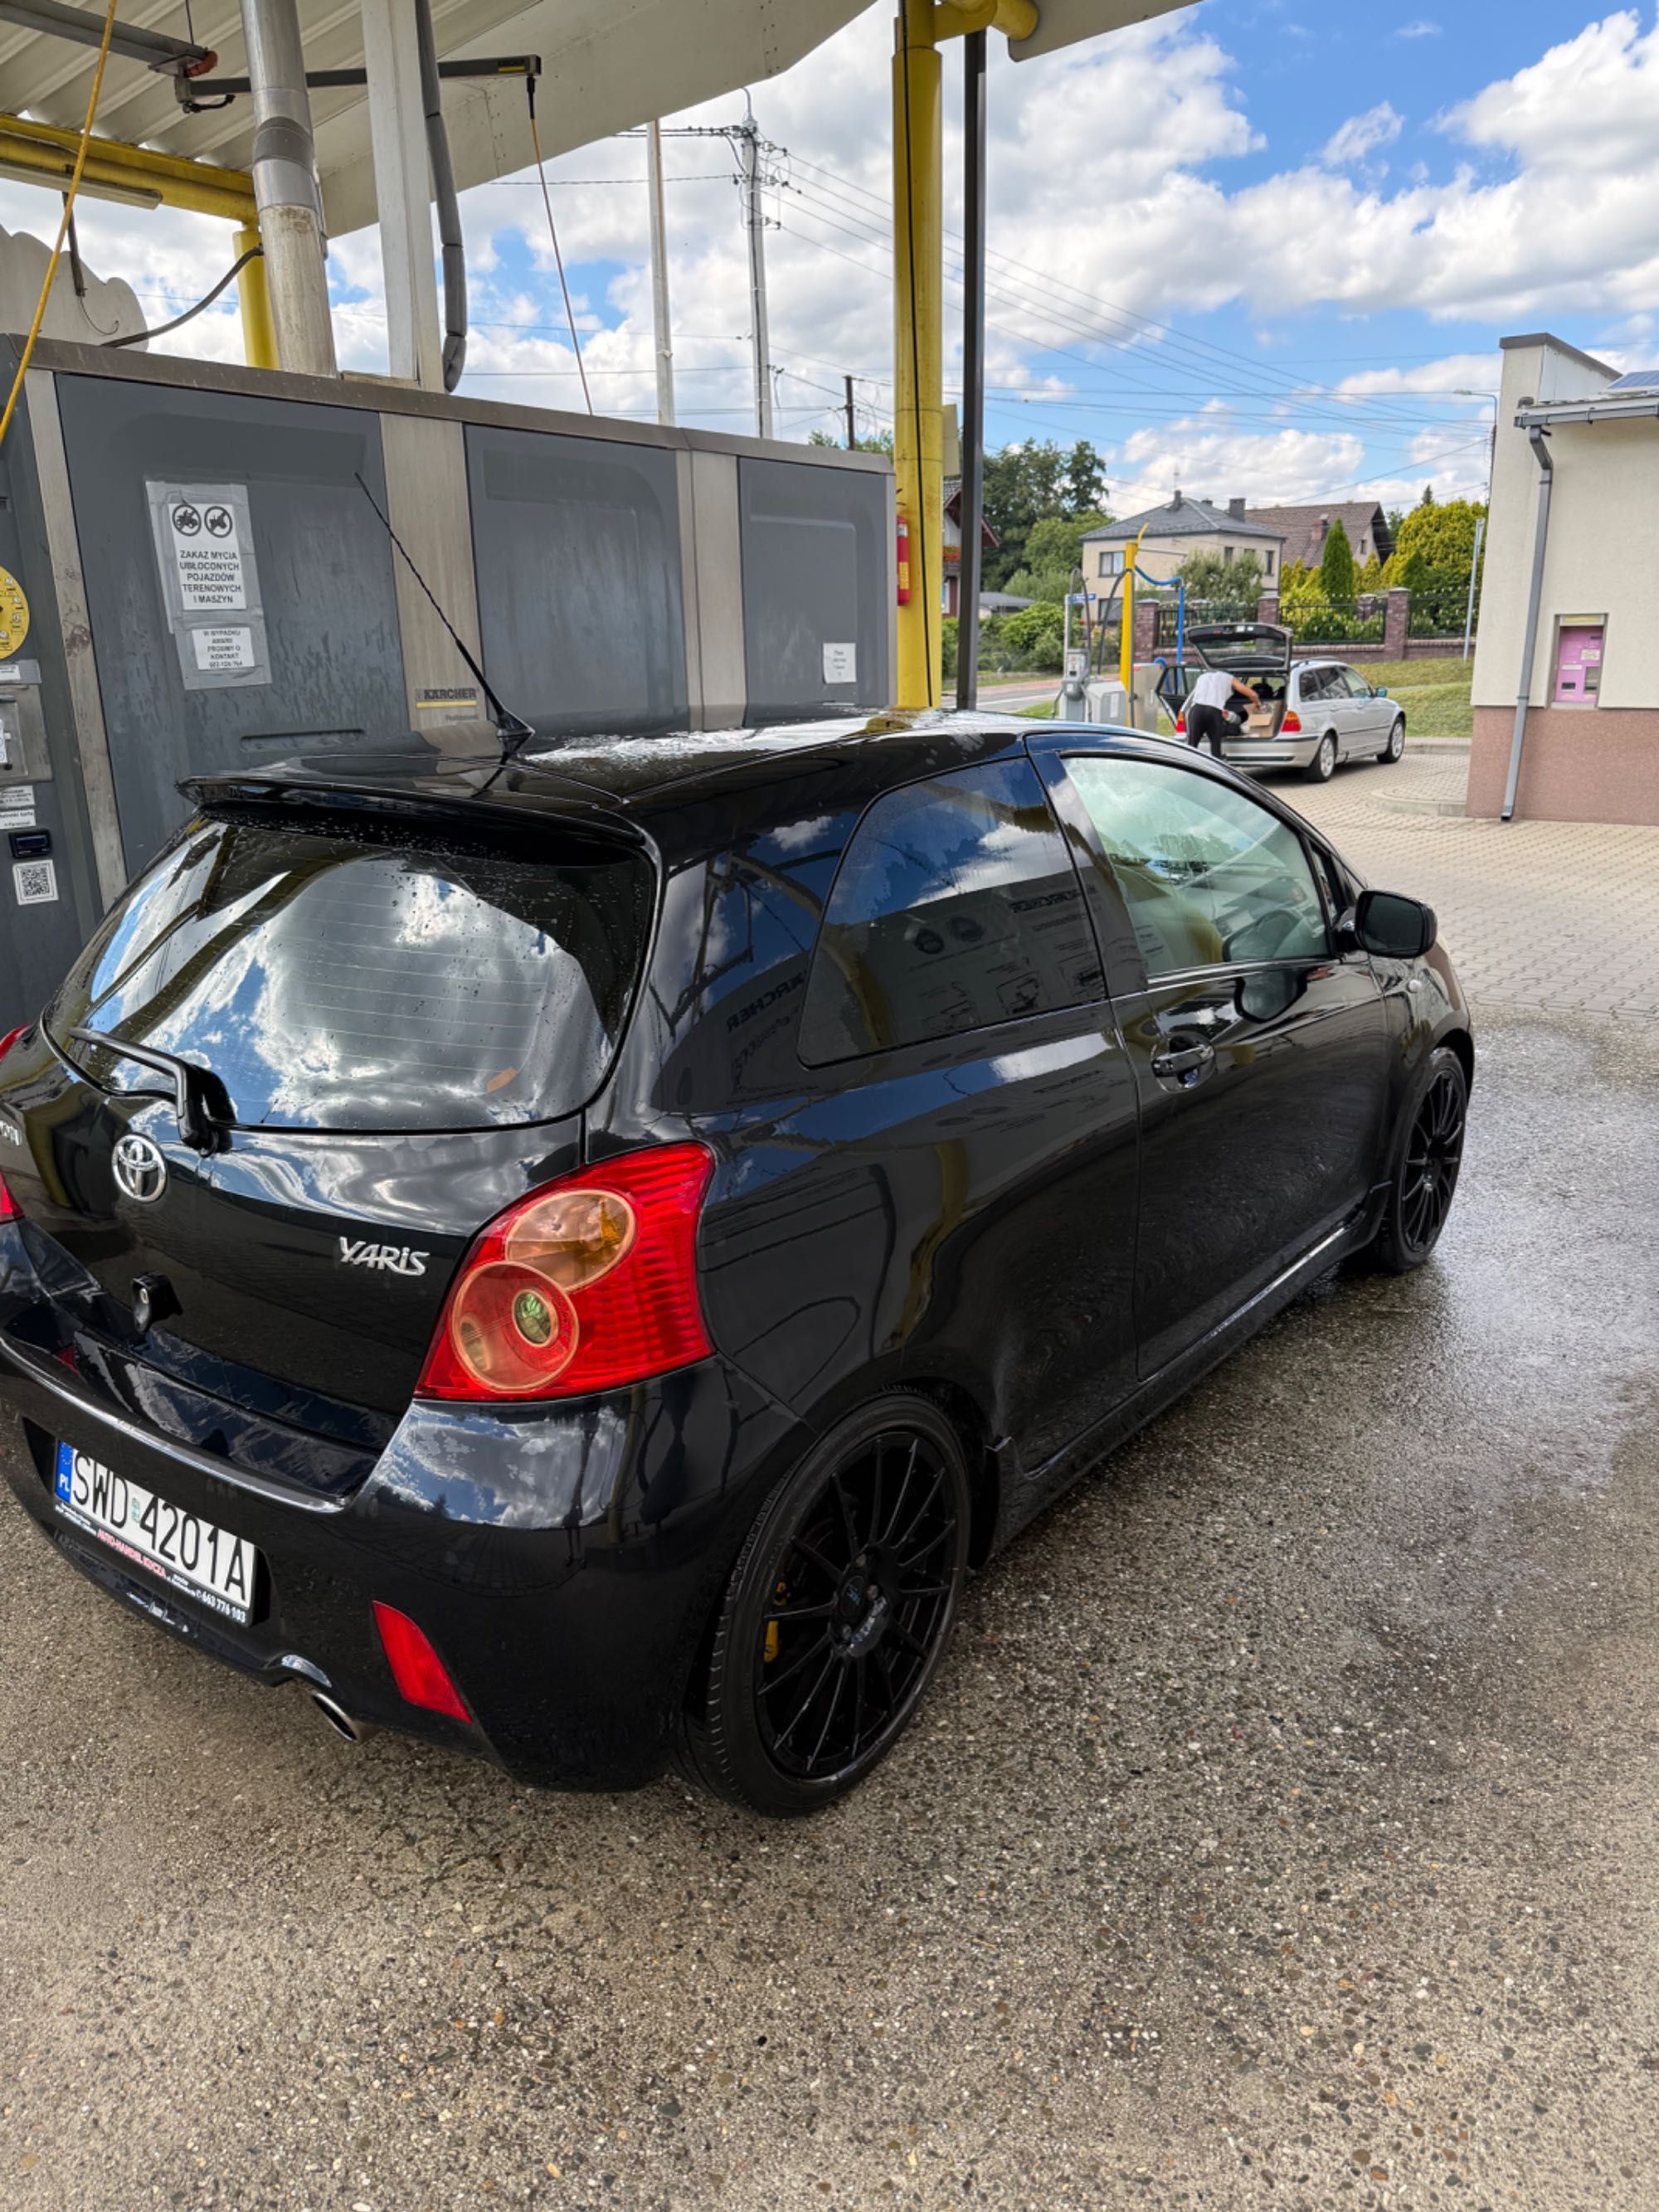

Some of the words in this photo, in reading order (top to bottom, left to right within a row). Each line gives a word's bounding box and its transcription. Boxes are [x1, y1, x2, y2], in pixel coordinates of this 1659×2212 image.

[179, 550, 209, 559] ZAKAZ
[210, 551, 237, 560] MYCIA
[187, 572, 235, 581] POJAZDÓW
[182, 584, 242, 592] TERENOWYCH
[198, 595, 233, 603] MASZYN
[59, 1473, 70, 1492] PL
[73, 1452, 128, 1529] SWD
[139, 1495, 246, 1602] 4201A
